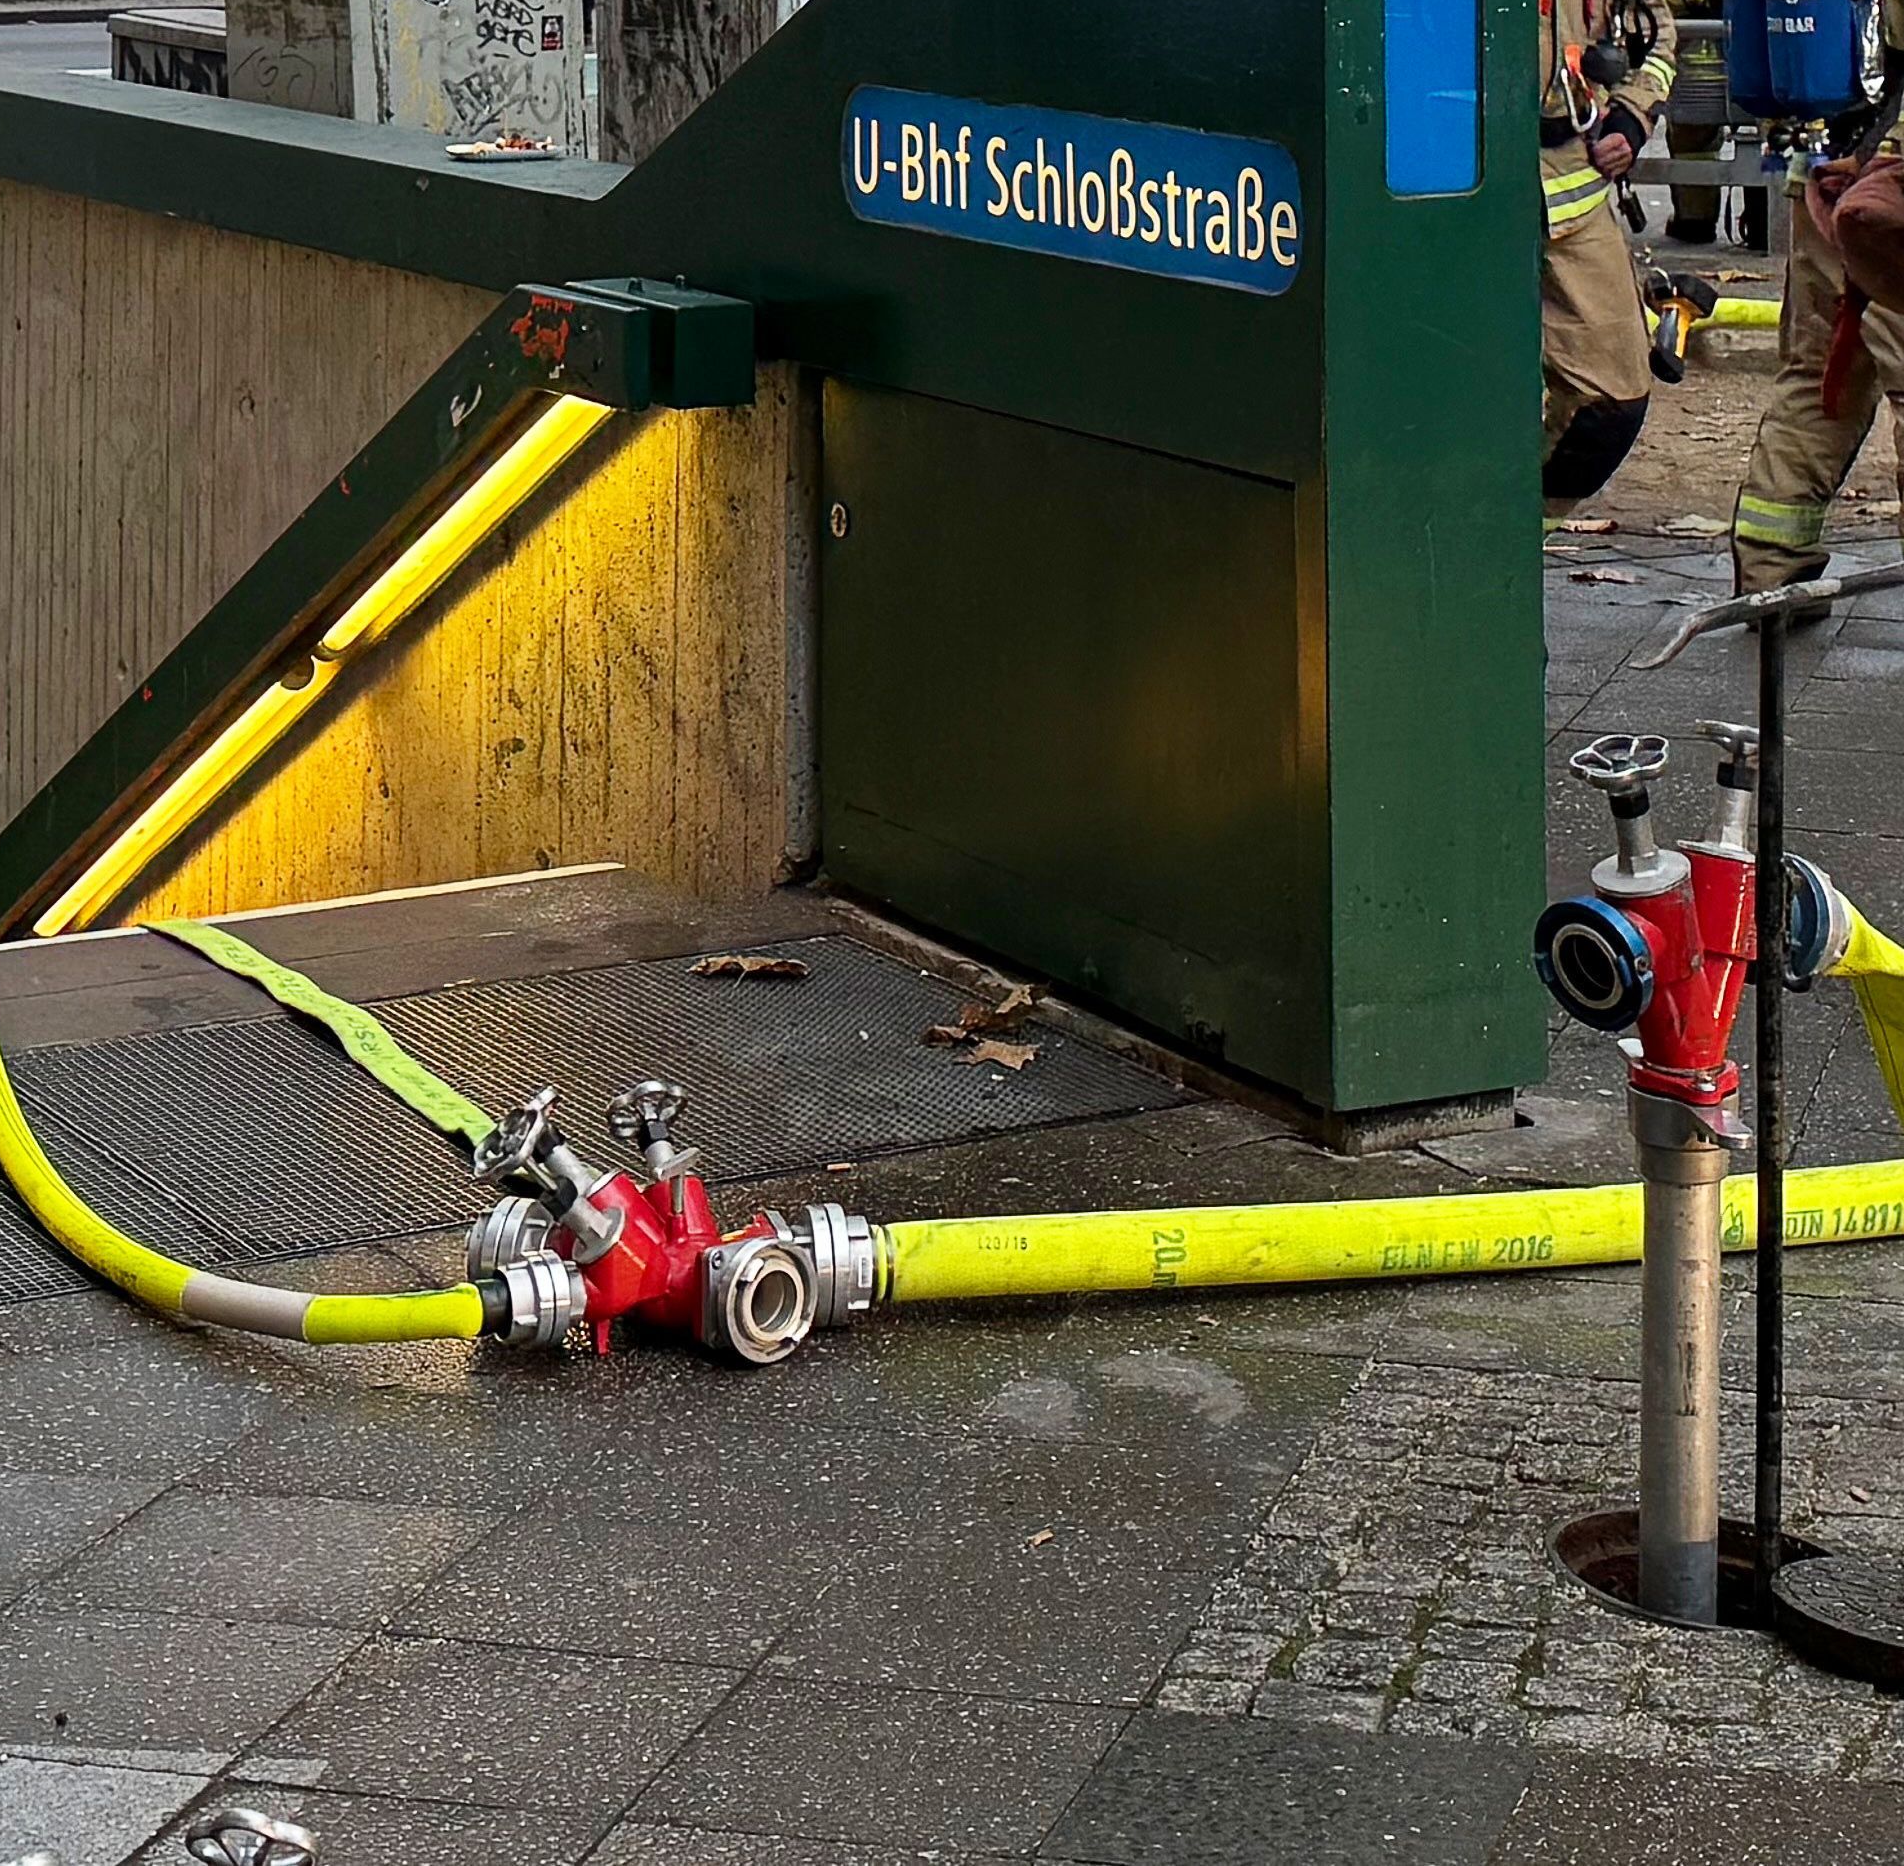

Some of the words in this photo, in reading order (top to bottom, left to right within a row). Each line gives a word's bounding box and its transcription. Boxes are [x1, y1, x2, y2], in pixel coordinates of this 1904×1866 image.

[853, 117, 972, 210] U-Bhf
[985, 136, 1298, 268] Schloßstraße
[1785, 1209, 1824, 1239] DIN
[1832, 1201, 1904, 1237] 14811
[1490, 1233, 1554, 1264] 2016
